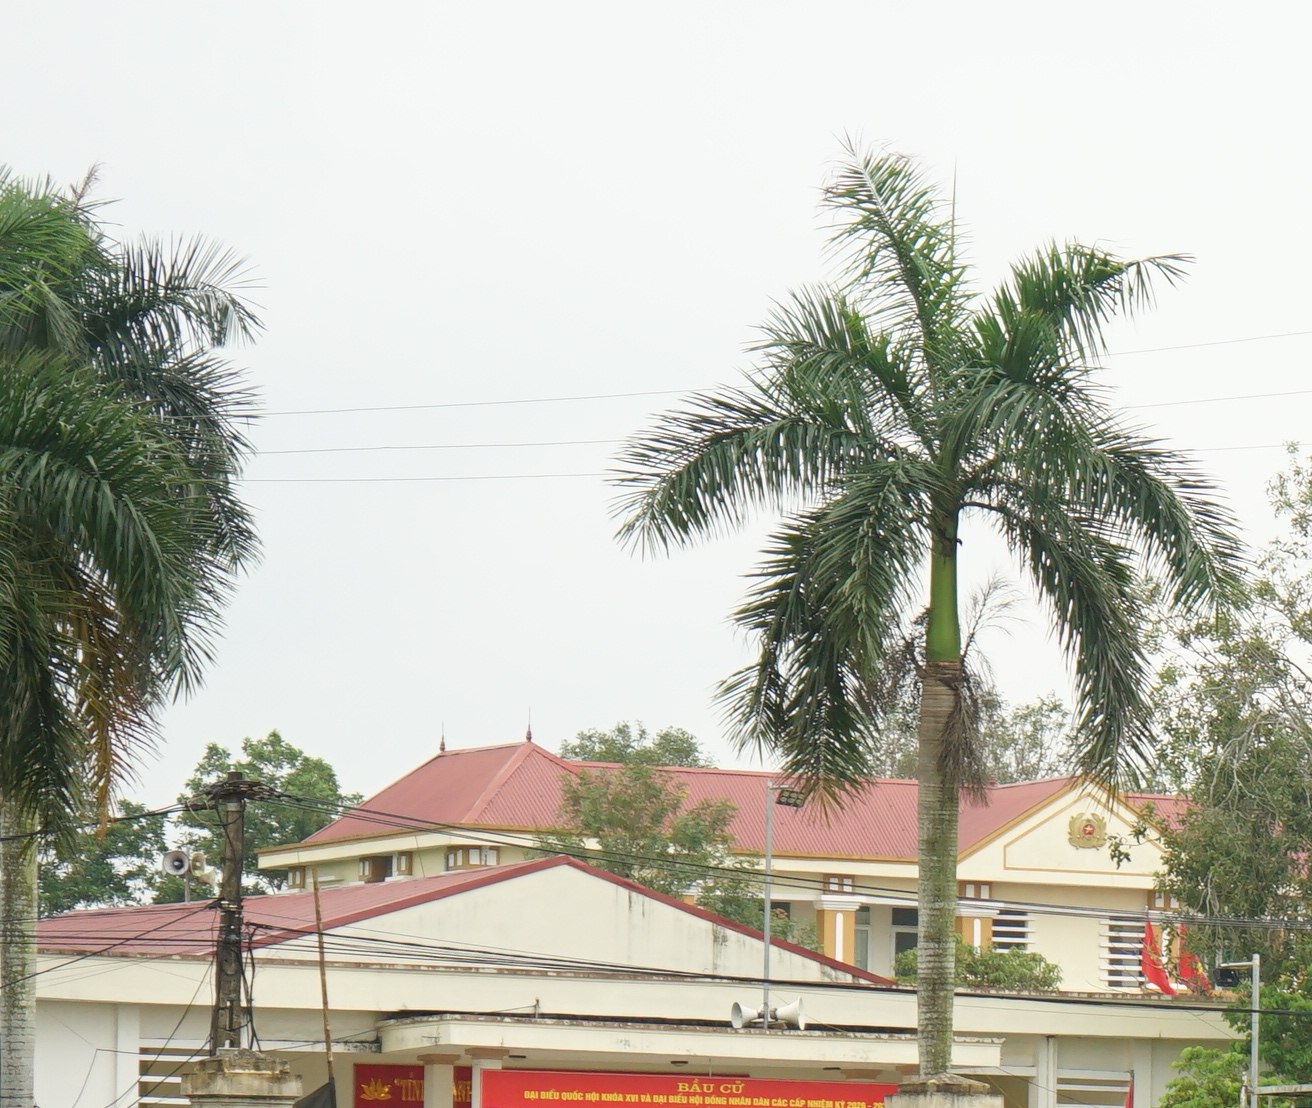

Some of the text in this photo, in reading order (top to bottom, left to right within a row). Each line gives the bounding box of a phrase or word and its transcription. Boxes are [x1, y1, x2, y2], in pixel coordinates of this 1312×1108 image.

[677, 1079, 745, 1094] BẦU CỬ
[524, 1090, 539, 1101] ĐẠI
[540, 1088, 560, 1100] BIỂU
[561, 1090, 584, 1102] QUỐC
[585, 1092, 600, 1103] HỘI
[625, 1093, 639, 1103] XVI
[640, 1093, 652, 1103] VÀ
[653, 1094, 667, 1105] ĐẠI
[669, 1093, 687, 1104] BIỂU
[689, 1094, 703, 1106] HỘI
[704, 1095, 727, 1105] ĐỒNG
[729, 1096, 751, 1106] NHÂN
[753, 1097, 770, 1107] DÂN
[771, 1097, 788, 1108] CÁC
[789, 1096, 806, 1108] CẤP
